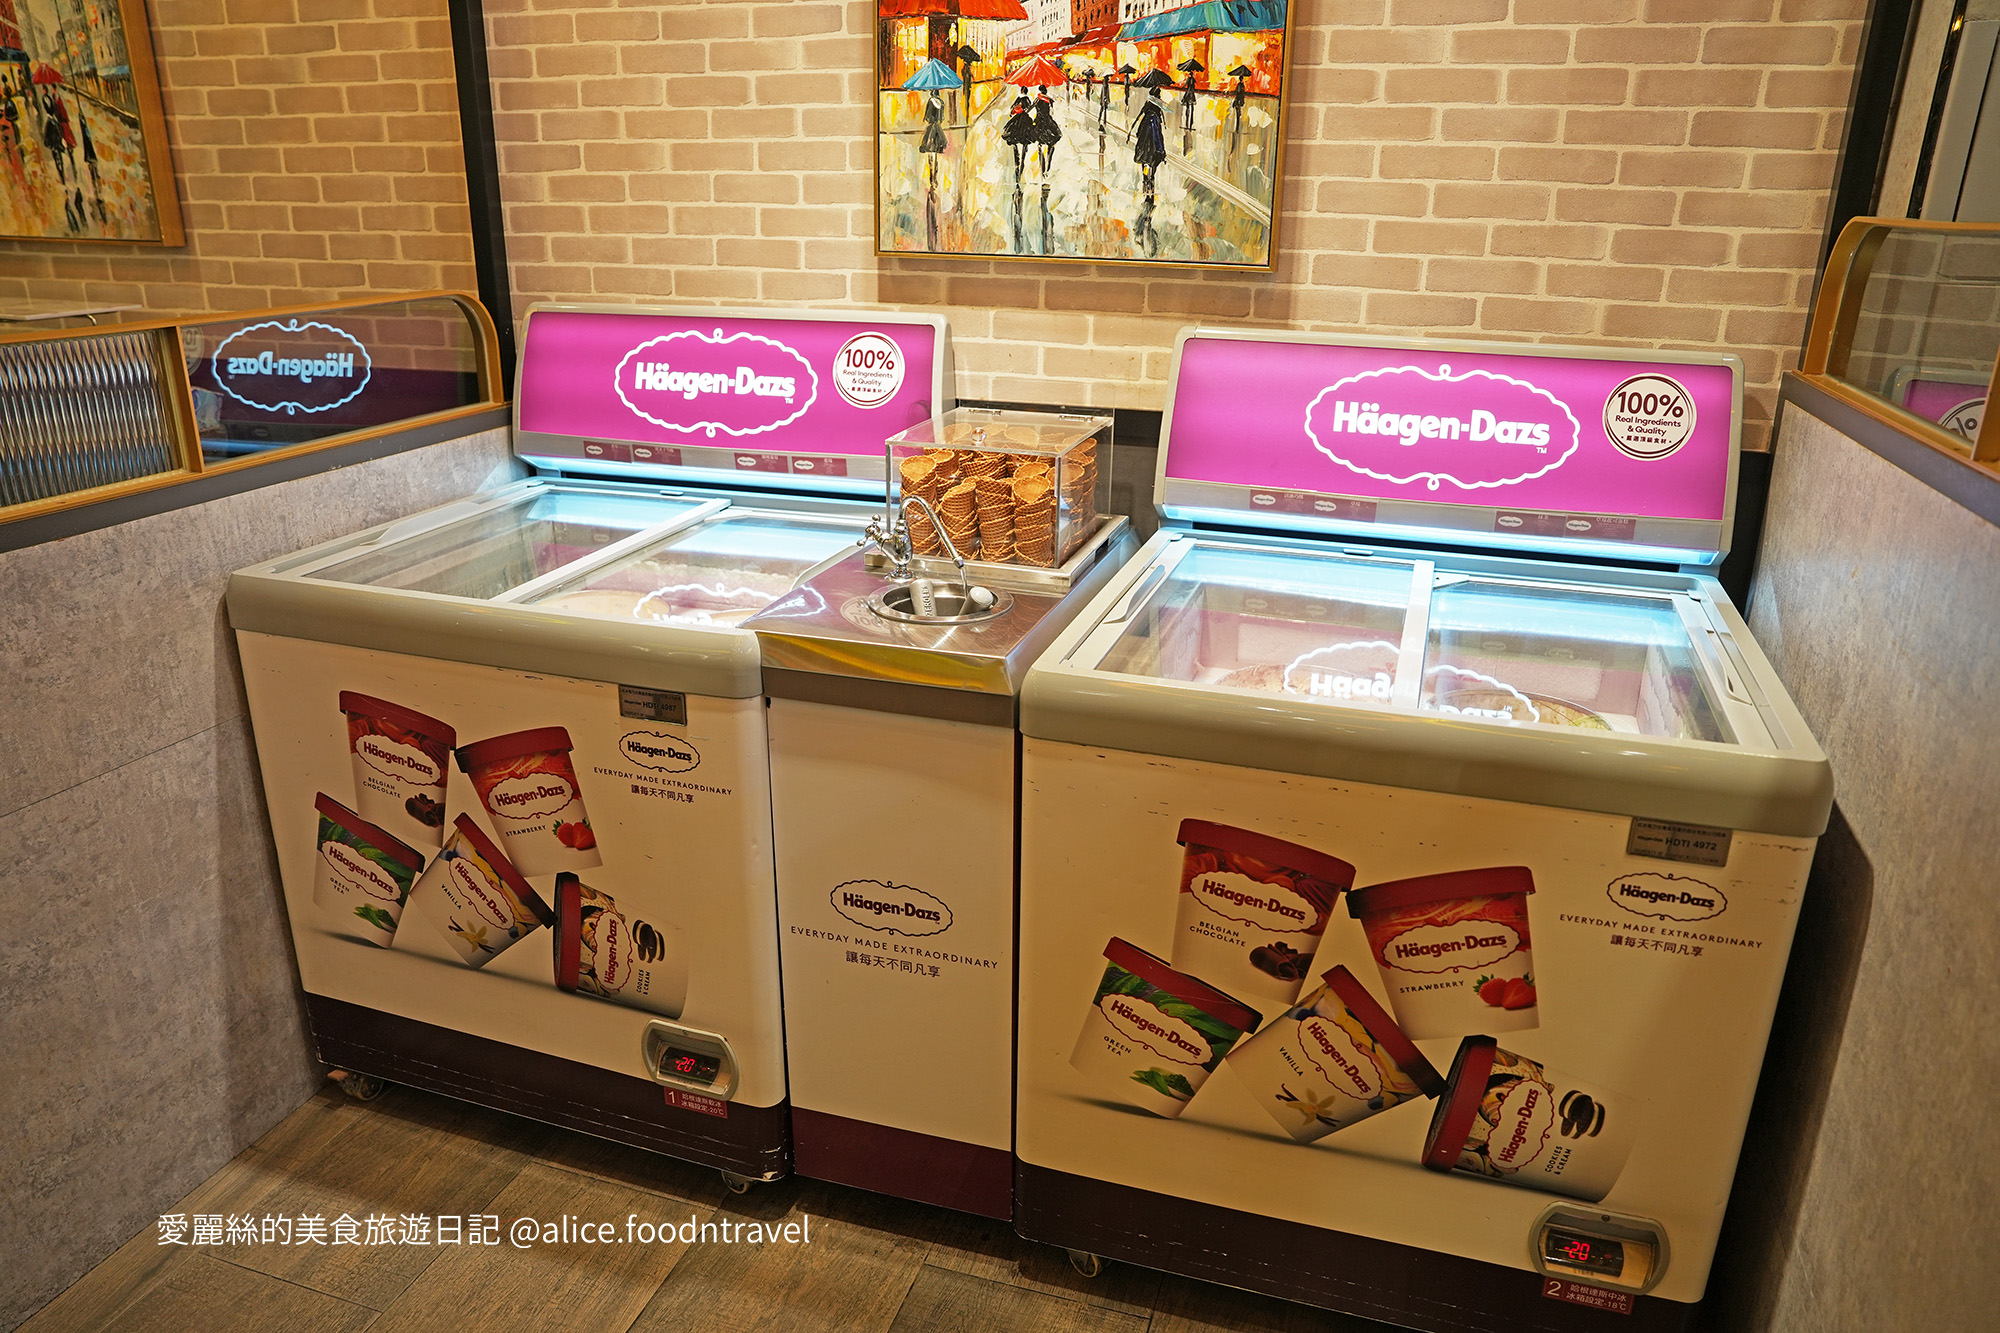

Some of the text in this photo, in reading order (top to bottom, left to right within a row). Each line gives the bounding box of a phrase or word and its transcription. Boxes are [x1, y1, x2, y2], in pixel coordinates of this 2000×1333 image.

[845, 349, 894, 370] 100%
[634, 362, 796, 400] Häagen-Dazs
[858, 370, 893, 378] Ingredients
[858, 378, 882, 386] Quality
[1618, 392, 1684, 418] 100%
[1332, 400, 1550, 446] Häagen-Dazs
[1616, 414, 1681, 427] Real Ingredients
[1635, 426, 1667, 436] Quality
[364, 741, 433, 776] Häagen-Dazs
[627, 741, 692, 761] Häagen-Dazs
[363, 782, 400, 798] CHOCOLATE
[368, 777, 395, 790] BELGIAN
[594, 767, 732, 796] EVERYDAY MADE EXTRAORDINARY
[494, 785, 565, 807] Häagen-Dazs
[631, 784, 694, 804] 讓每天不同凡享
[506, 825, 546, 837] STRAWBERRY
[1693, 841, 1717, 851] 4972
[329, 847, 394, 894] Häagen-Dazs
[330, 877, 350, 892] GREEN
[333, 884, 344, 894] TEA
[454, 862, 509, 925] Häagen-Dazs
[441, 884, 462, 910] VANILLA
[843, 892, 940, 921] Häagen-Dazs
[1202, 879, 1306, 921] Häagen-Dazs
[1620, 884, 1714, 908] Häagen-Dazs
[1189, 926, 1246, 947] CHOCOLATE
[1200, 921, 1240, 937] BELGIAN
[1560, 914, 1763, 948] EVERYDAY MADE EXTRAORDINARY
[604, 919, 619, 984] Häagen-Dazs
[791, 926, 998, 969] EVERYDAY MADE EXTRAORDINARY
[1395, 934, 1507, 958] Häagen-Dazs
[1610, 934, 1703, 957] 讓每天不同凡享
[846, 950, 941, 978] 讓每天不同凡享
[1400, 980, 1465, 993] STRAWBERRY
[1110, 1000, 1202, 1056] Häagen-Dazs
[1104, 1035, 1131, 1054] GREEN
[1107, 1045, 1121, 1056] TEA
[676, 1057, 695, 1073] -20
[1279, 1046, 1304, 1077] VANILLA
[1307, 1022, 1372, 1094] Häagen-Dazs
[668, 1091, 675, 1104] 1
[1498, 1088, 1539, 1163] Häagen-Dazs
[1544, 1145, 1562, 1172] COOKIES
[1558, 1148, 1572, 1169] CREAM
[1564, 1241, 1590, 1261] -20
[1547, 1281, 1562, 1297] 2
